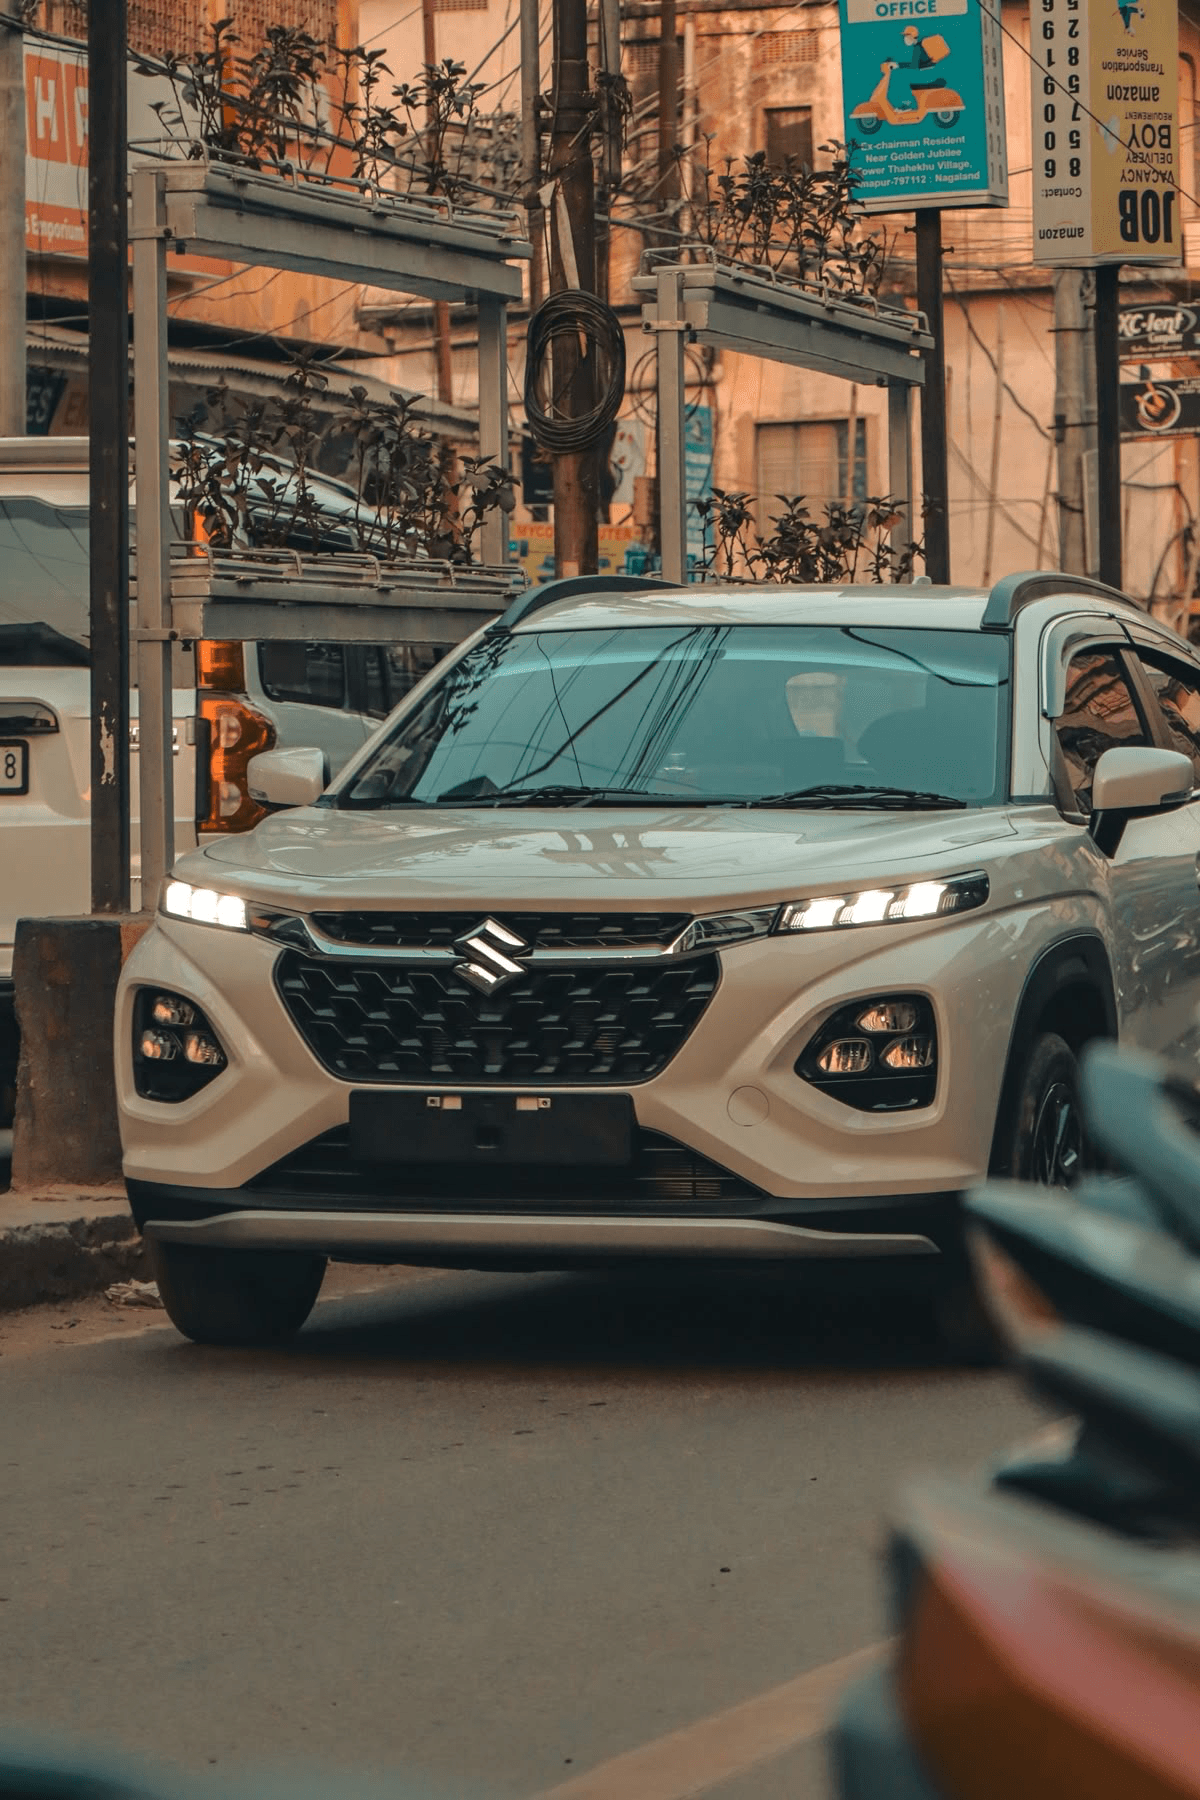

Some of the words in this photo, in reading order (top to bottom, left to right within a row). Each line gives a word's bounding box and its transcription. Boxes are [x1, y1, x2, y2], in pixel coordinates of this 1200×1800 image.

[875, 0, 937, 17] OFFICE
[1117, 48, 1149, 60] Service
[1102, 61, 1165, 75] Transportation
[1107, 85, 1160, 102] amazon
[1125, 112, 1173, 121] REQUIREMENT
[923, 135, 966, 147] Resident
[1128, 124, 1172, 149] BOY
[866, 153, 888, 164] Near
[890, 150, 925, 163] Golden
[927, 148, 962, 159] Jubilee
[1126, 152, 1173, 164] DELIVERY
[935, 172, 980, 184] Nagaland
[1120, 169, 1175, 184] VACANCY
[1041, 187, 1083, 198] Contact:
[1118, 190, 1175, 243] JOB
[1039, 227, 1085, 240] amazon
